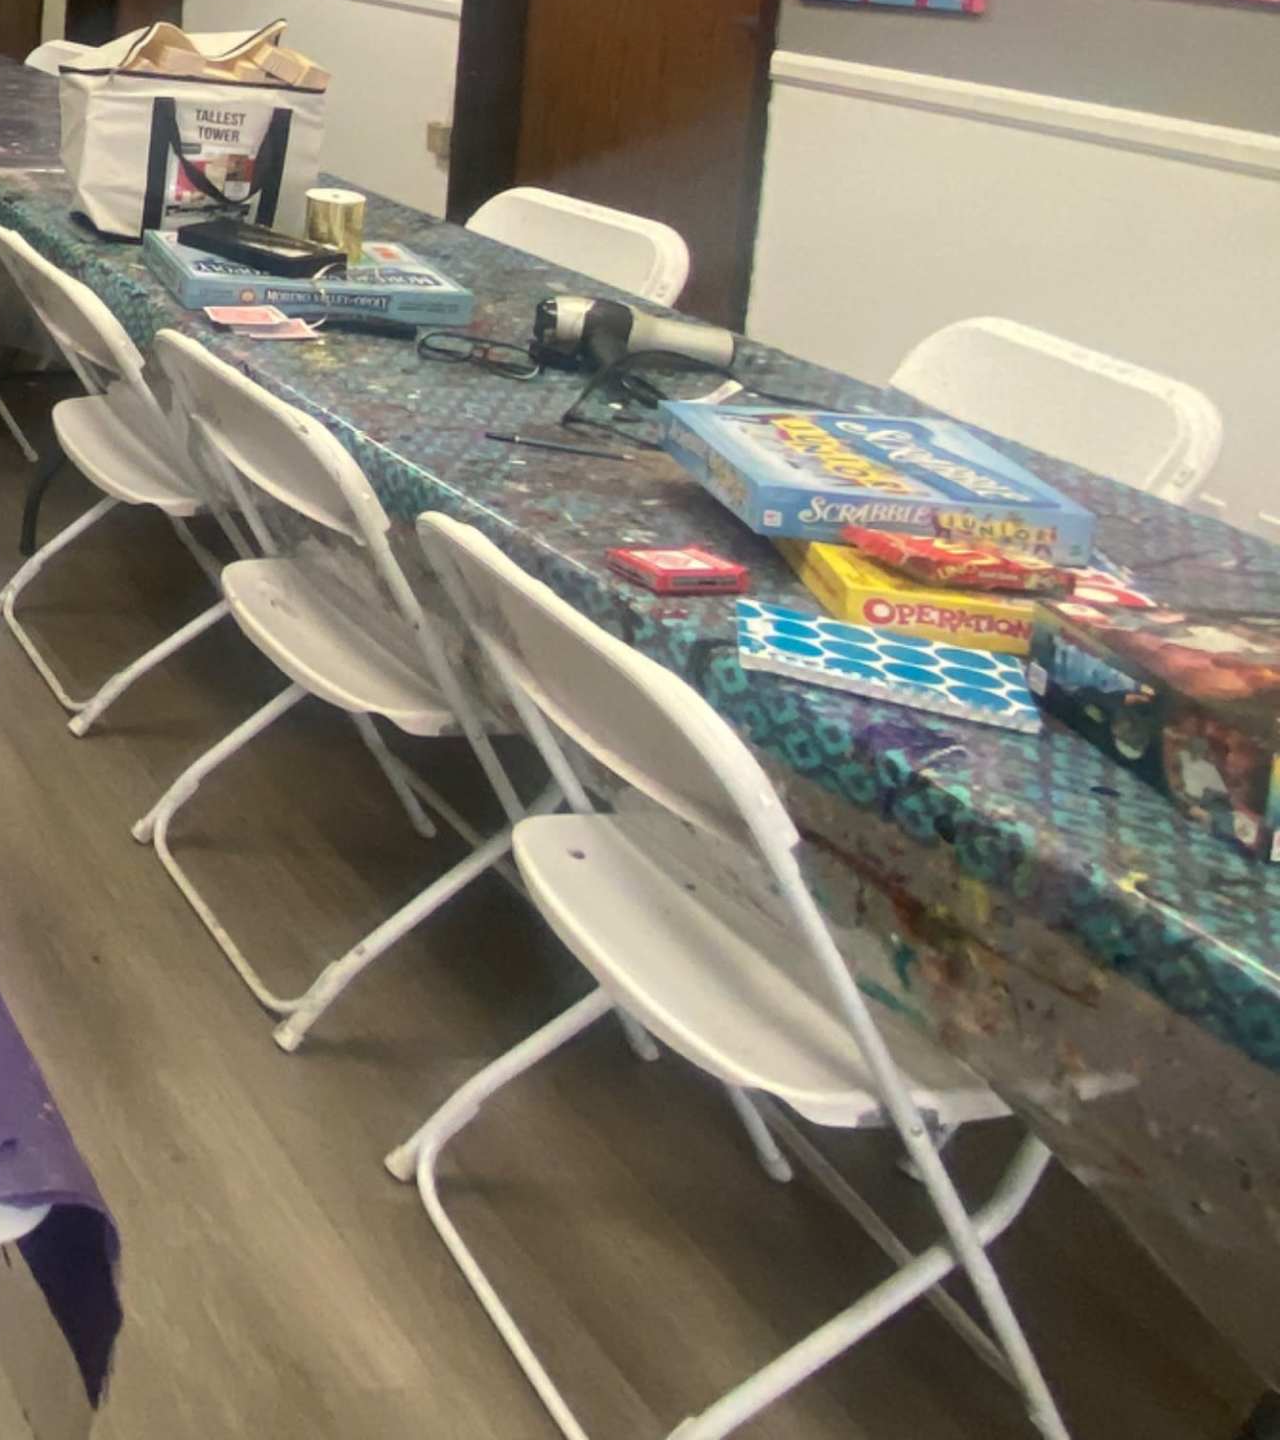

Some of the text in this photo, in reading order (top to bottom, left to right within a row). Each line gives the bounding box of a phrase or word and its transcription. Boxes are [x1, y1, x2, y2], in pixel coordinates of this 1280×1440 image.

[195, 109, 247, 127] TALLEST
[197, 126, 241, 143] TOWER
[797, 495, 932, 527] SCRABBLE
[863, 597, 1033, 641] OPERATION
